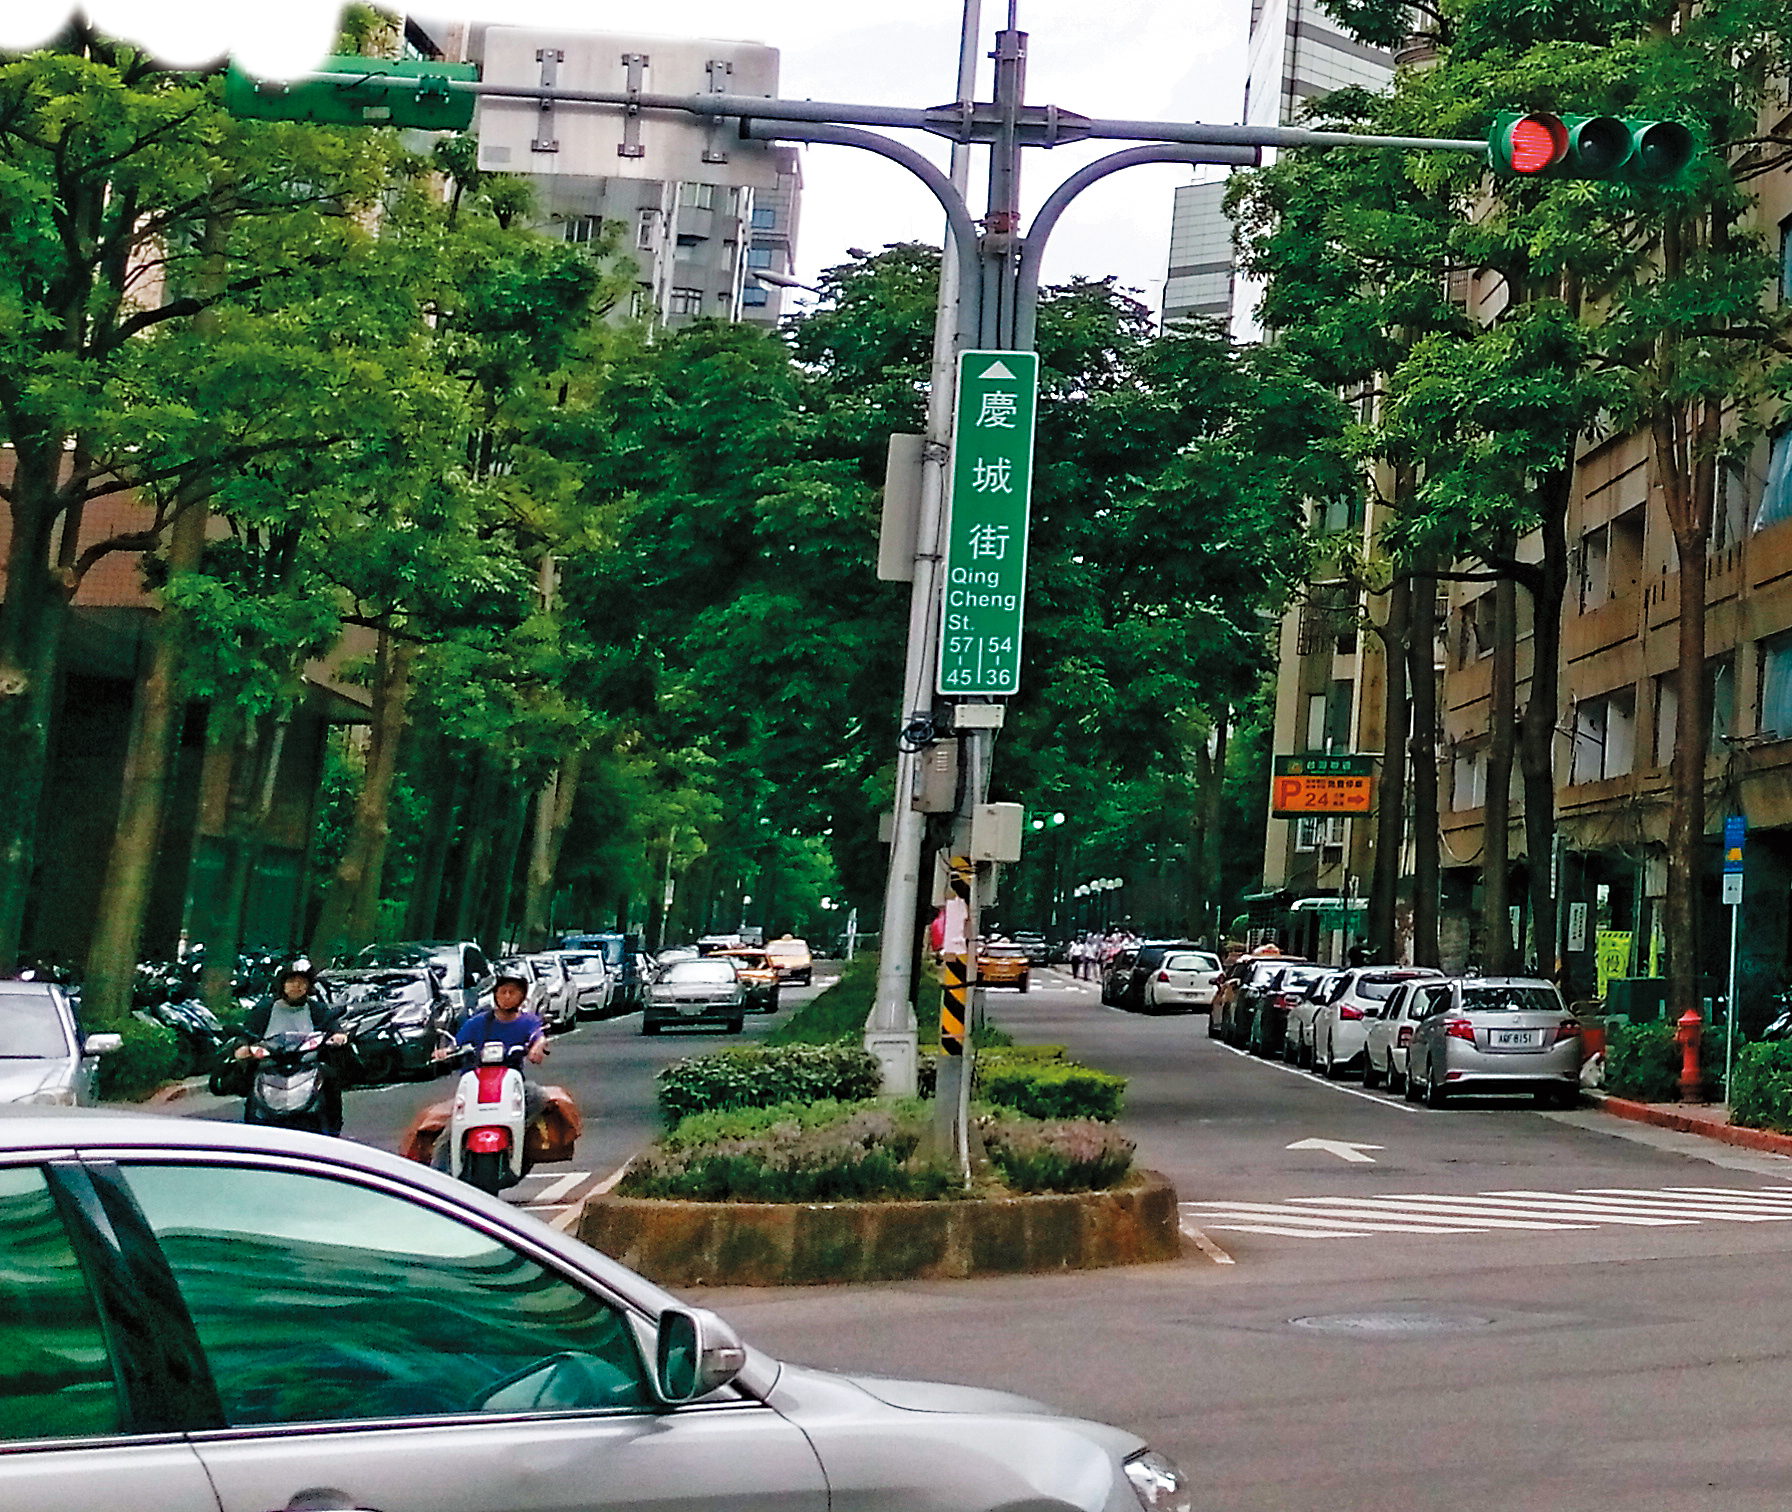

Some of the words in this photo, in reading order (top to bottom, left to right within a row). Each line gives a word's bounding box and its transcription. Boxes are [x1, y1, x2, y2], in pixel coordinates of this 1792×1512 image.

[969, 390, 1018, 560] 慶城街
[951, 566, 1000, 589] Qing
[950, 591, 1017, 612] Cheng
[948, 614, 976, 632] St.
[950, 637, 974, 654] 57
[988, 637, 1013, 654] 54
[946, 669, 972, 686] 45
[986, 669, 1011, 686] 36
[1281, 780, 1302, 808] P
[1304, 792, 1329, 807] 24
